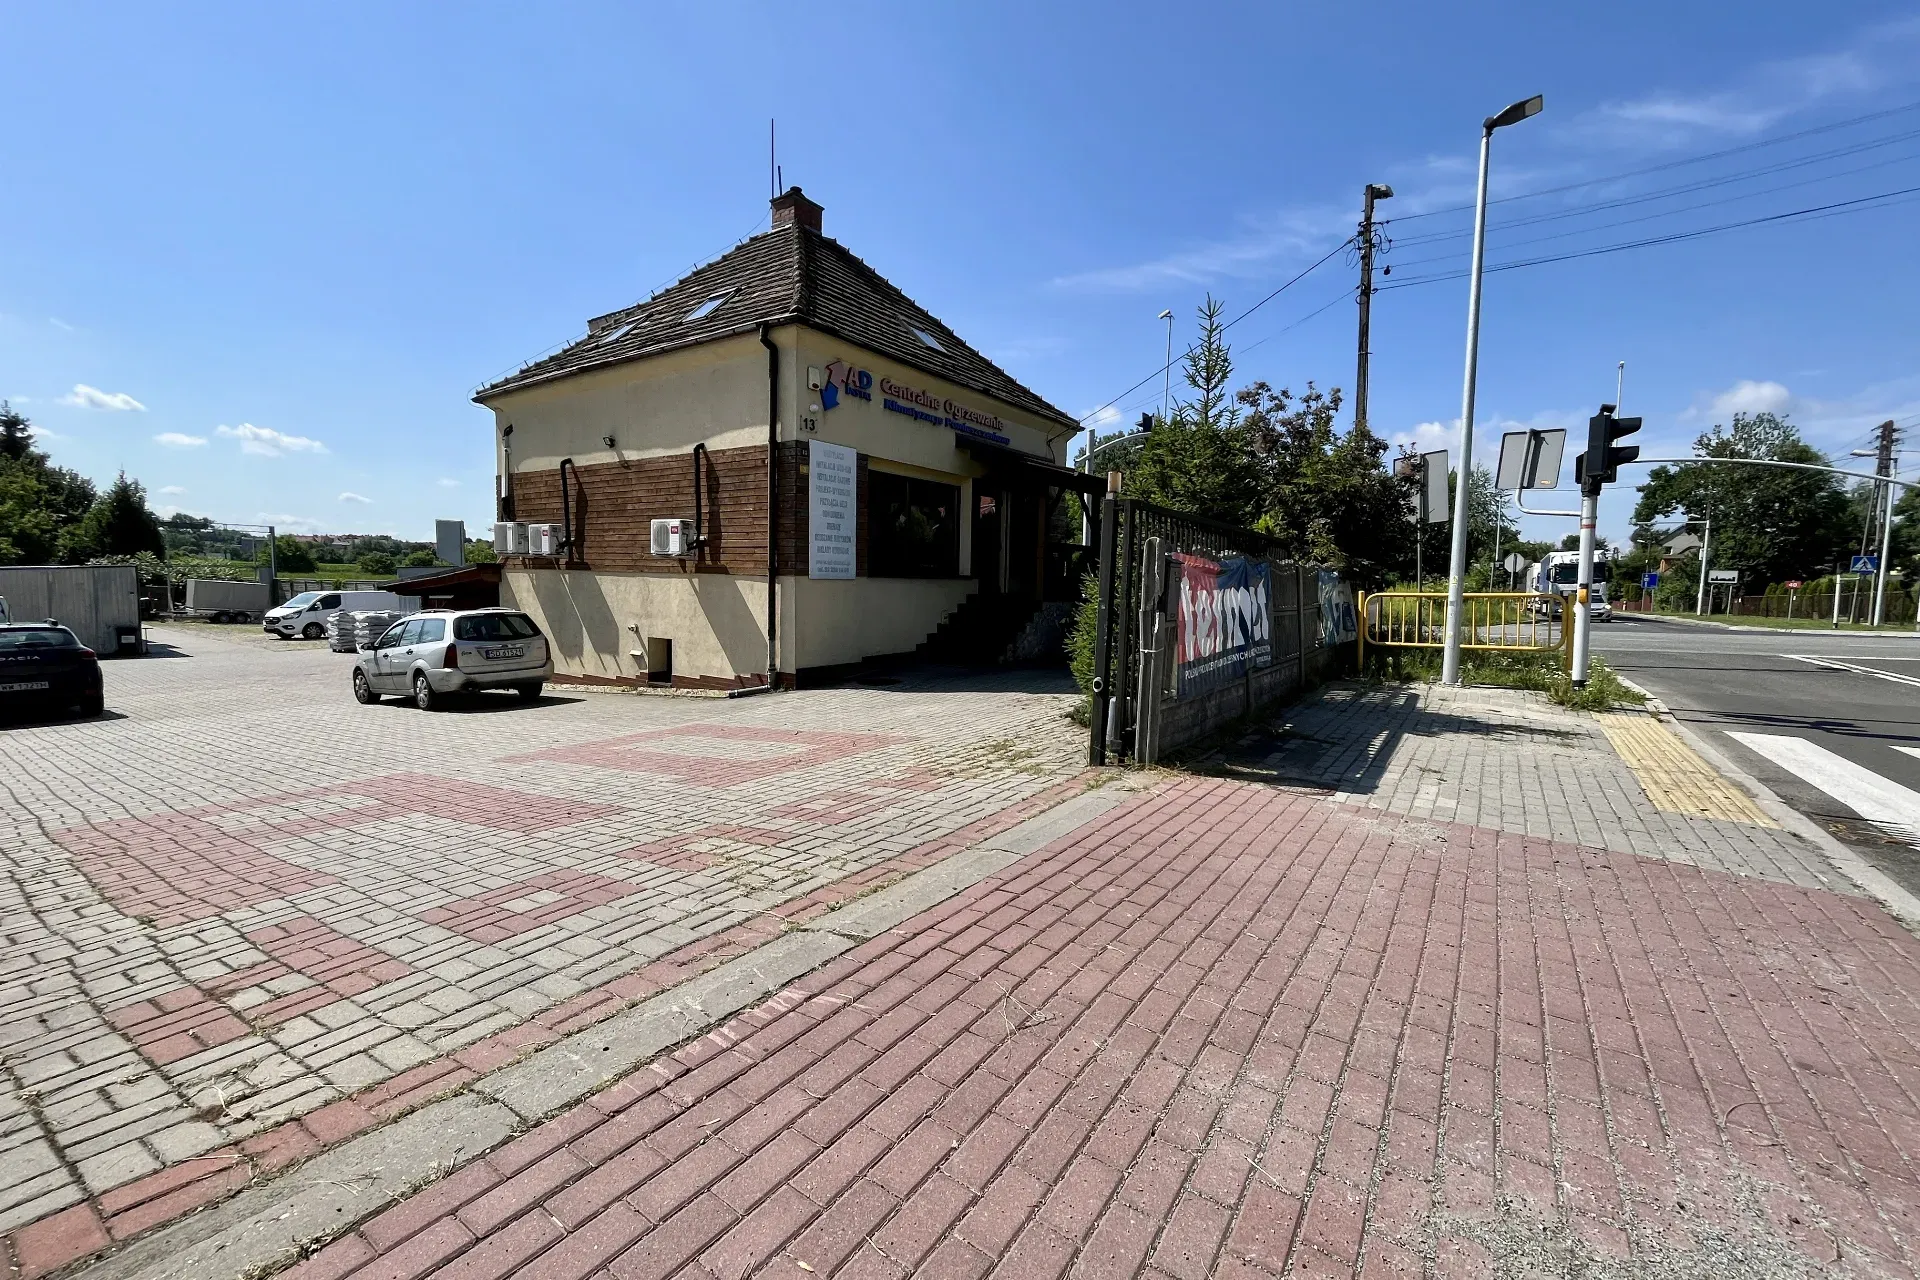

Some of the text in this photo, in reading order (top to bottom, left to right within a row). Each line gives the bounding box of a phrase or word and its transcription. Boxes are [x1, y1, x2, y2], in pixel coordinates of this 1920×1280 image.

[846, 366, 873, 390] AD
[880, 377, 1004, 432] Centralne Ogrzewanie
[803, 417, 816, 432] 13
